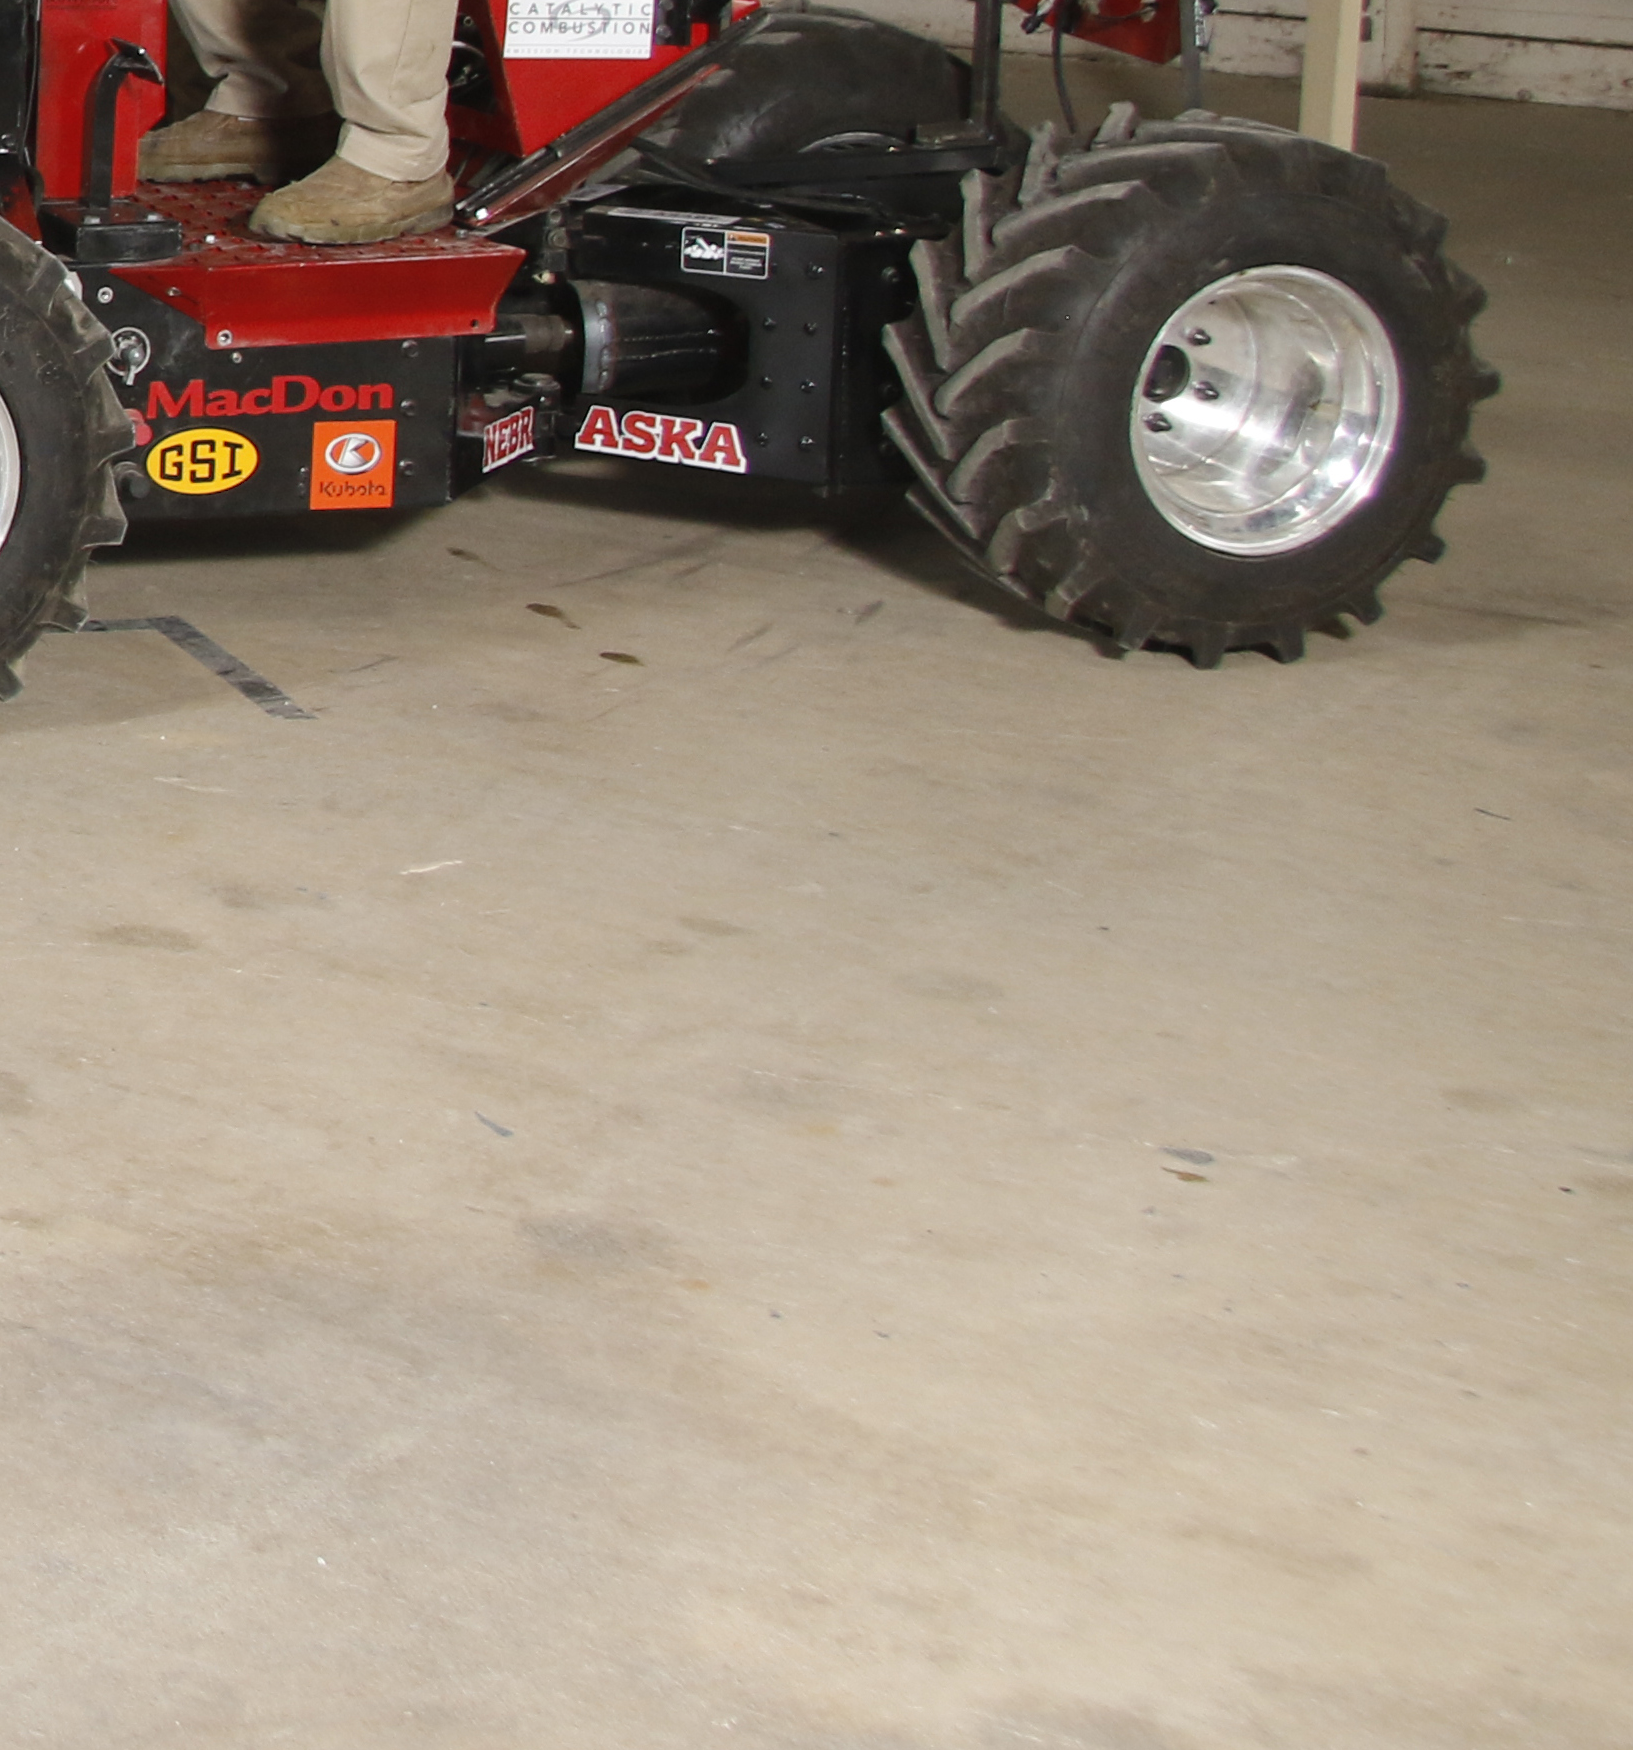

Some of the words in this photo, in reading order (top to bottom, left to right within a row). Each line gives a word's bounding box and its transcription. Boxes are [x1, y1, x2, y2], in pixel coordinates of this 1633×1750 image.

[508, 21, 651, 35] COMBUSTION
[509, 2, 651, 16] CATALYTIC
[146, 374, 395, 420] MacDon
[160, 439, 245, 485] GSI
[482, 406, 535, 474] NEBR
[574, 404, 747, 474] ASKA
[319, 479, 388, 498] Kubota
